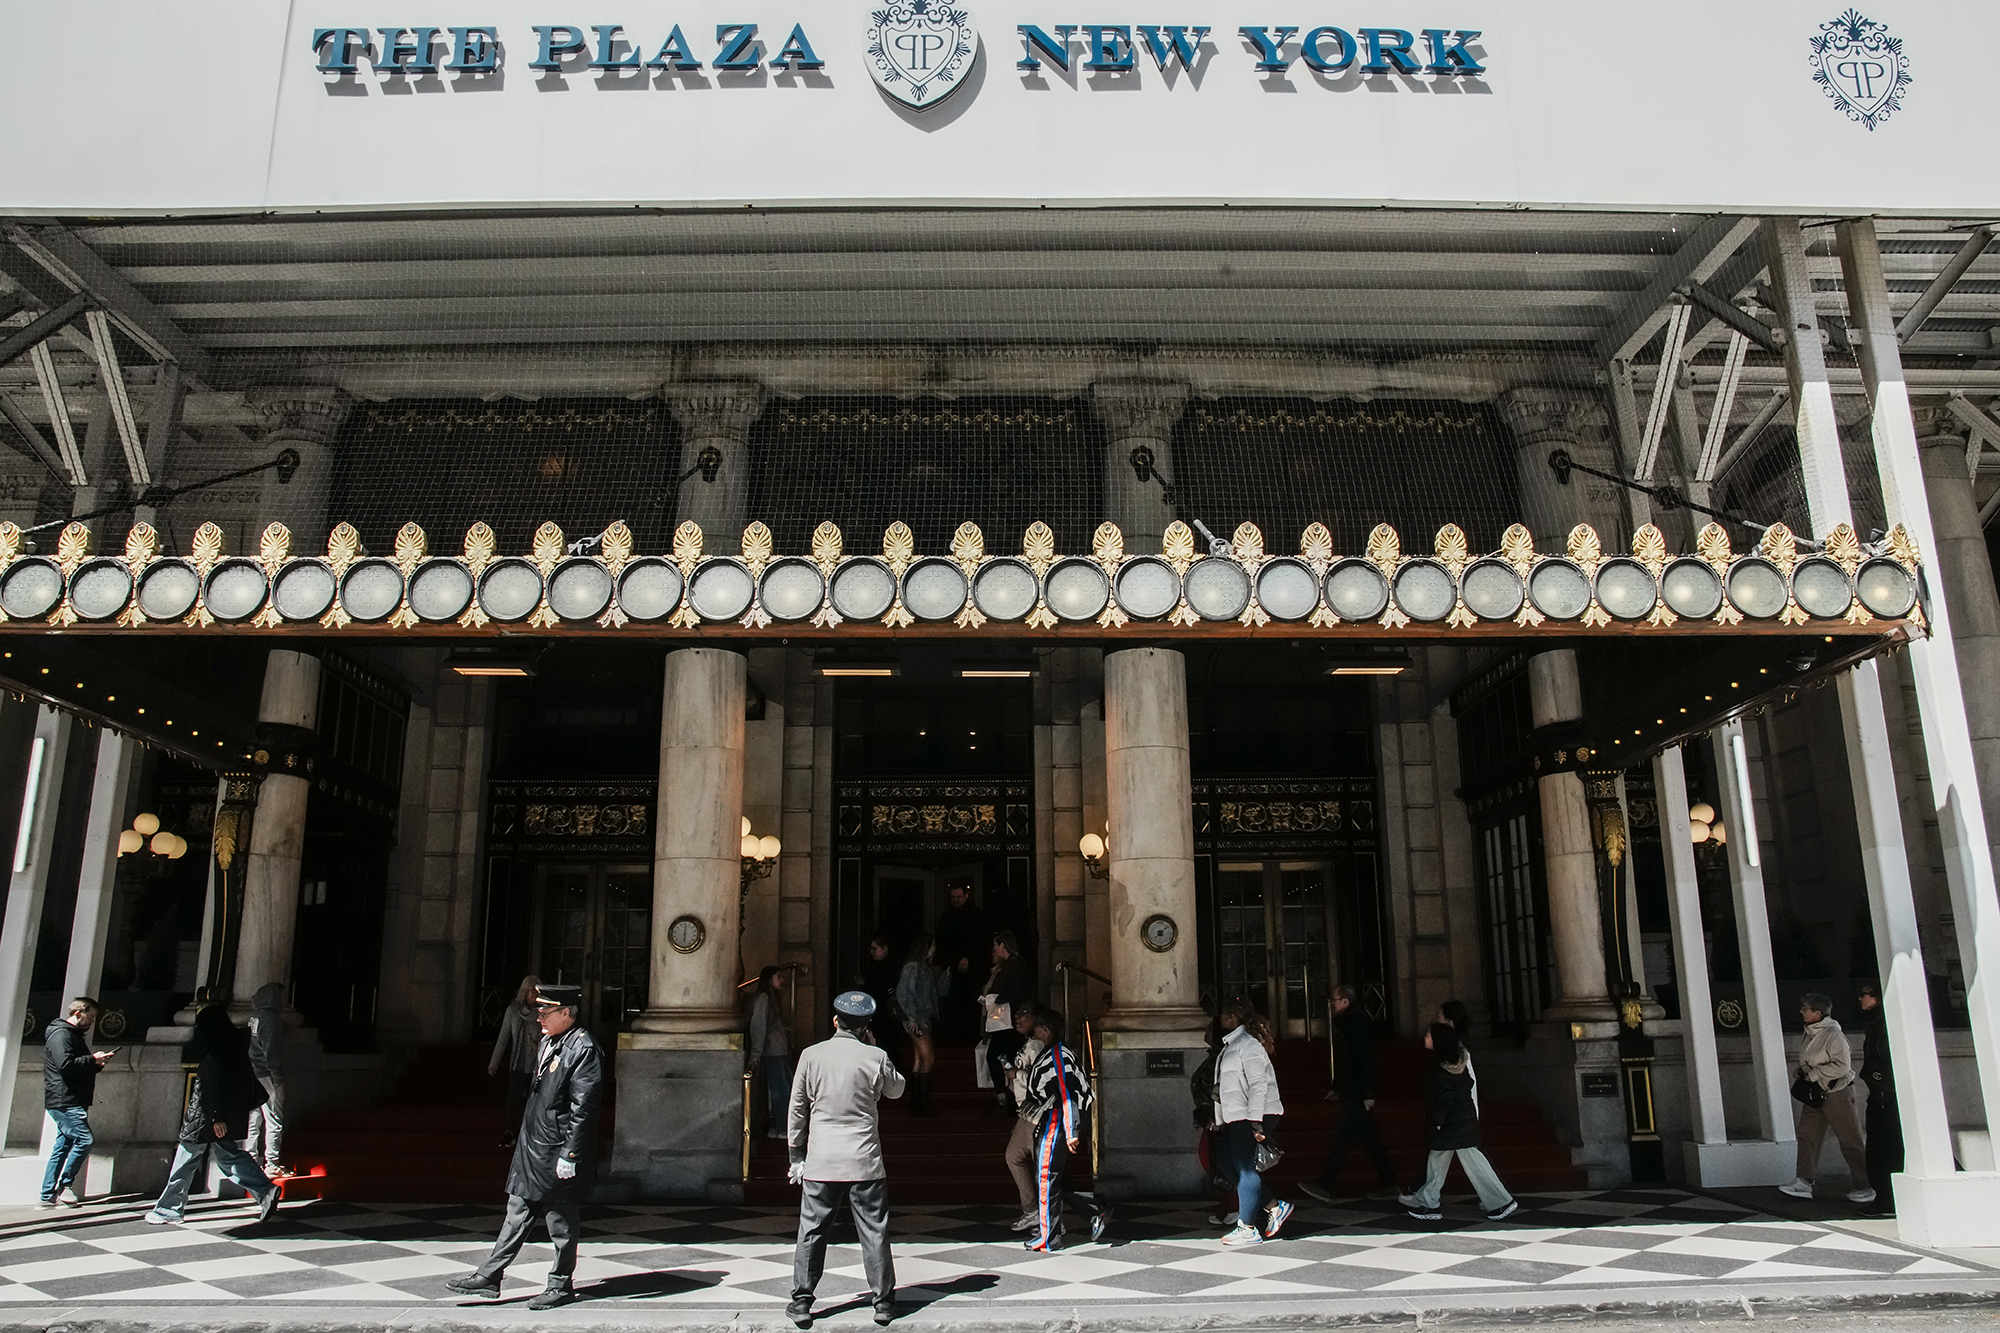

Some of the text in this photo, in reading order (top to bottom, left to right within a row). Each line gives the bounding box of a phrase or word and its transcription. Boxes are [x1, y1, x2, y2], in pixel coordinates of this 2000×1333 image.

[312, 22, 1488, 76] THE PLAZA NEW YORK
